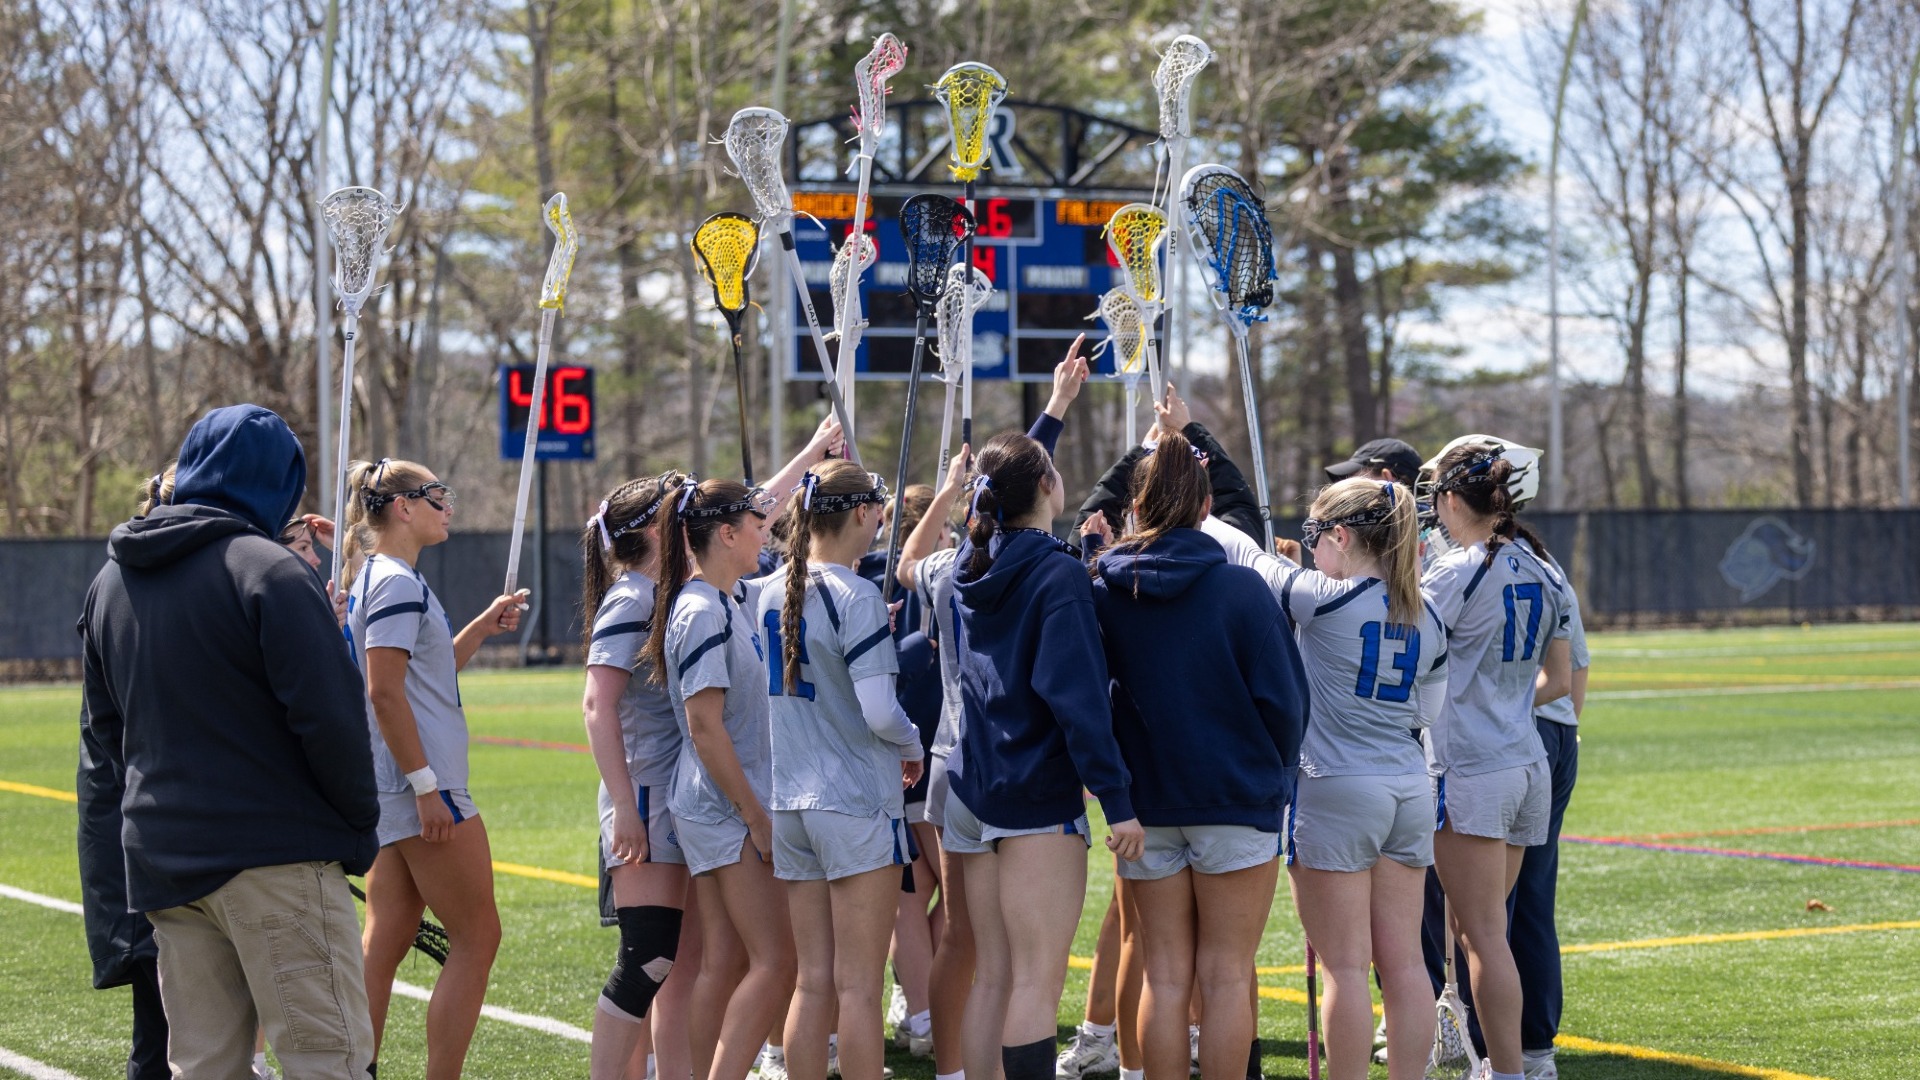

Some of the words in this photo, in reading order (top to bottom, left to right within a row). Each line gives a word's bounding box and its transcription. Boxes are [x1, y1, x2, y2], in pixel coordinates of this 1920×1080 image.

[1169, 230, 1177, 256] GAIT
[807, 303, 820, 328] GAIT
[509, 367, 591, 435] 46
[1446, 462, 1466, 480] STX
[700, 507, 723, 517] STX
[729, 500, 753, 512] STX
[850, 493, 871, 501] STX
[629, 513, 648, 528] GAIT
[1502, 582, 1544, 662] 17
[1354, 620, 1421, 703] 13
